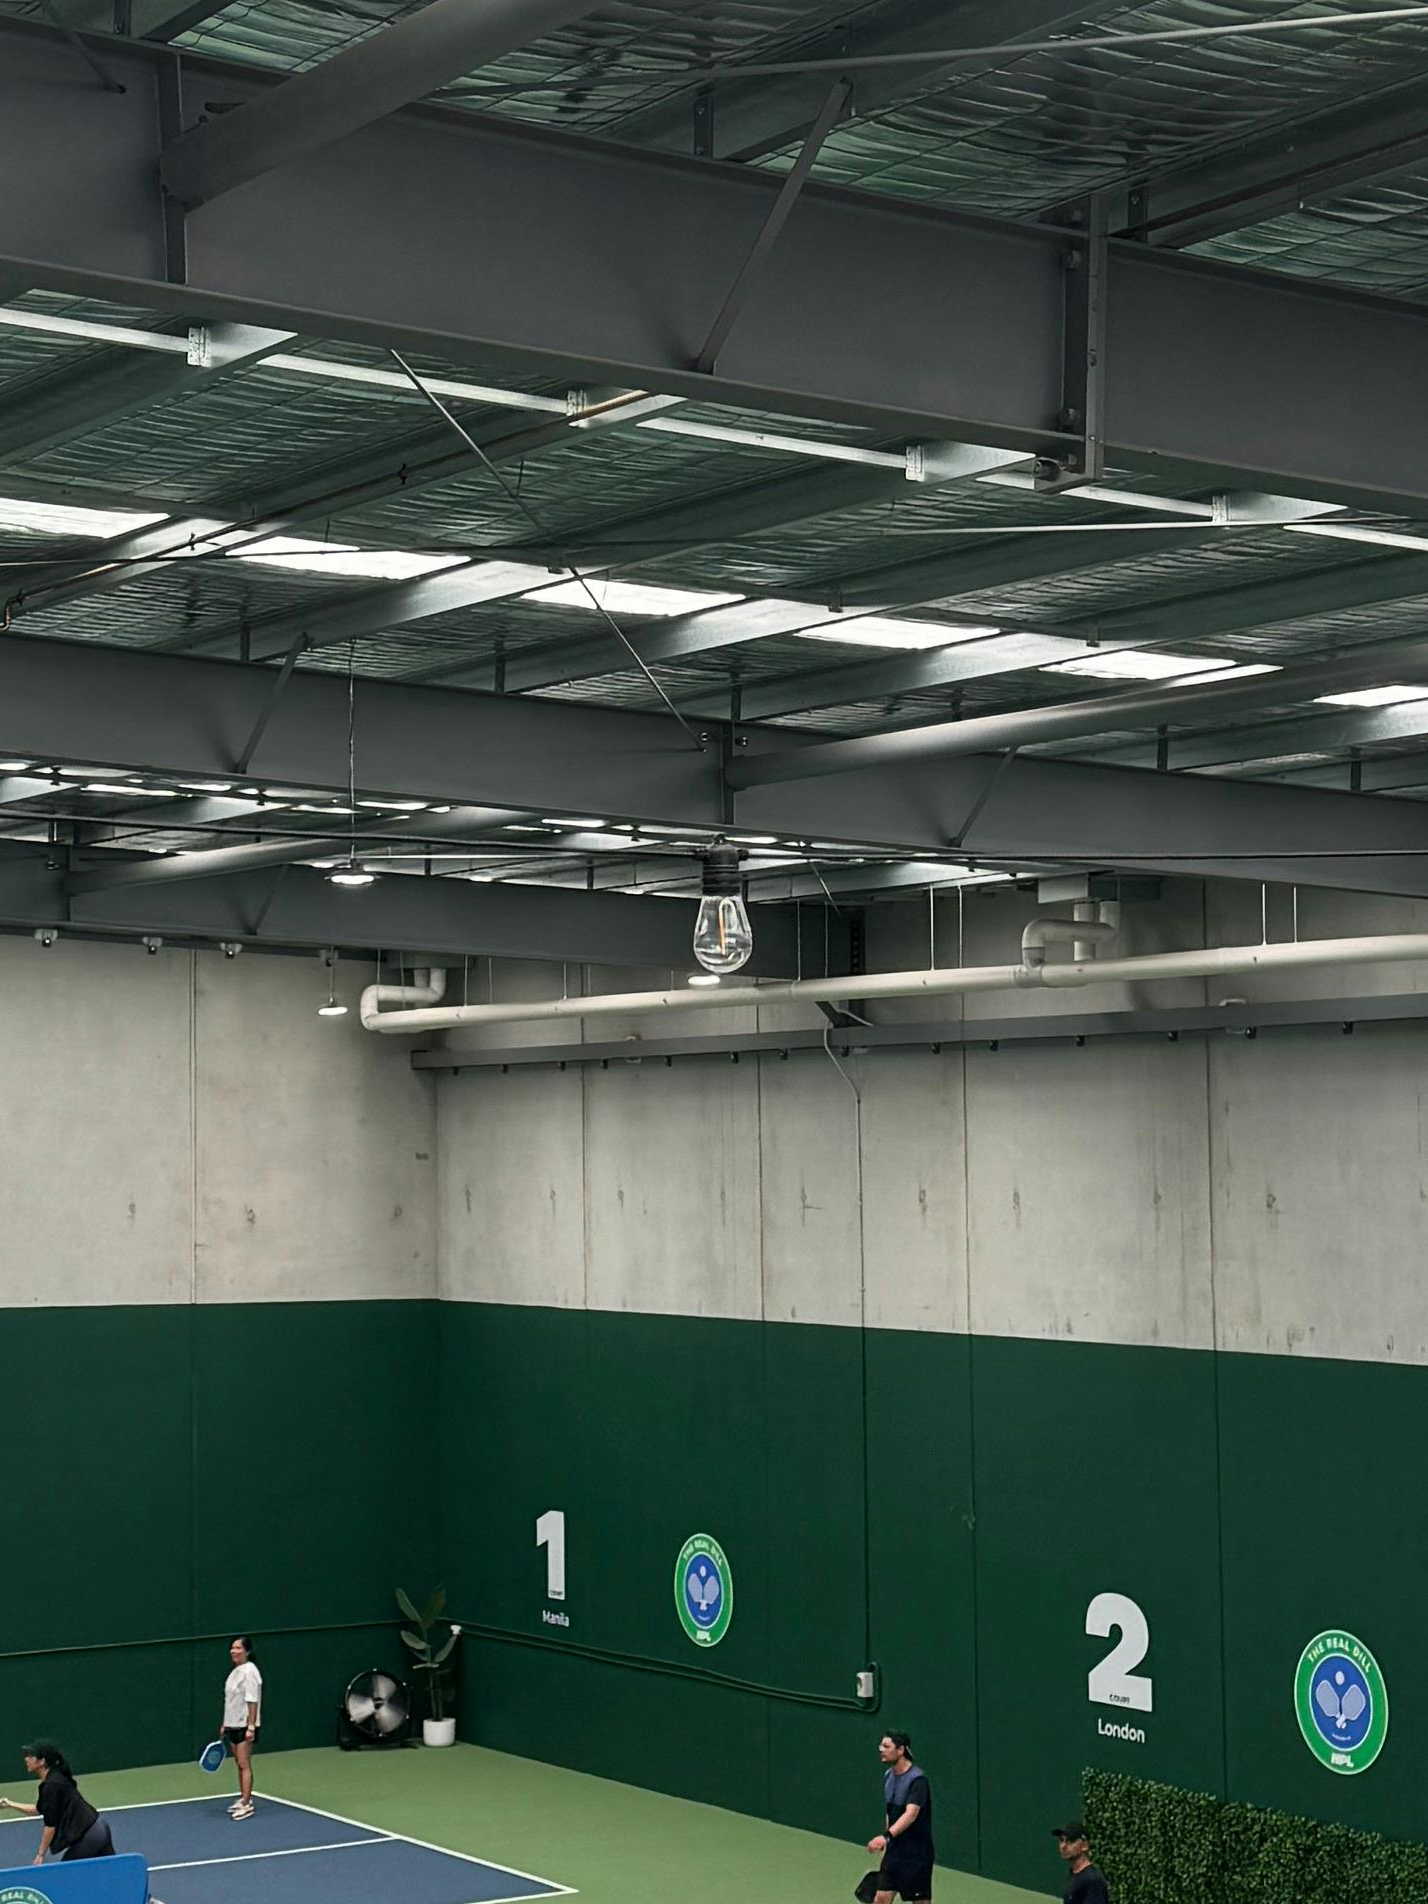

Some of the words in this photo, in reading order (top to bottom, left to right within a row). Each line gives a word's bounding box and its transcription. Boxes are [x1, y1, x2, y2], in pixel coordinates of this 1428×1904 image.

[536, 1510, 566, 1600] 1
[1084, 1592, 1152, 1712] 2
[1307, 1640, 1325, 1663] THE
[1326, 1637, 1350, 1652] REAL
[1352, 1645, 1371, 1673] DILL
[1098, 1717, 1145, 1744] London
